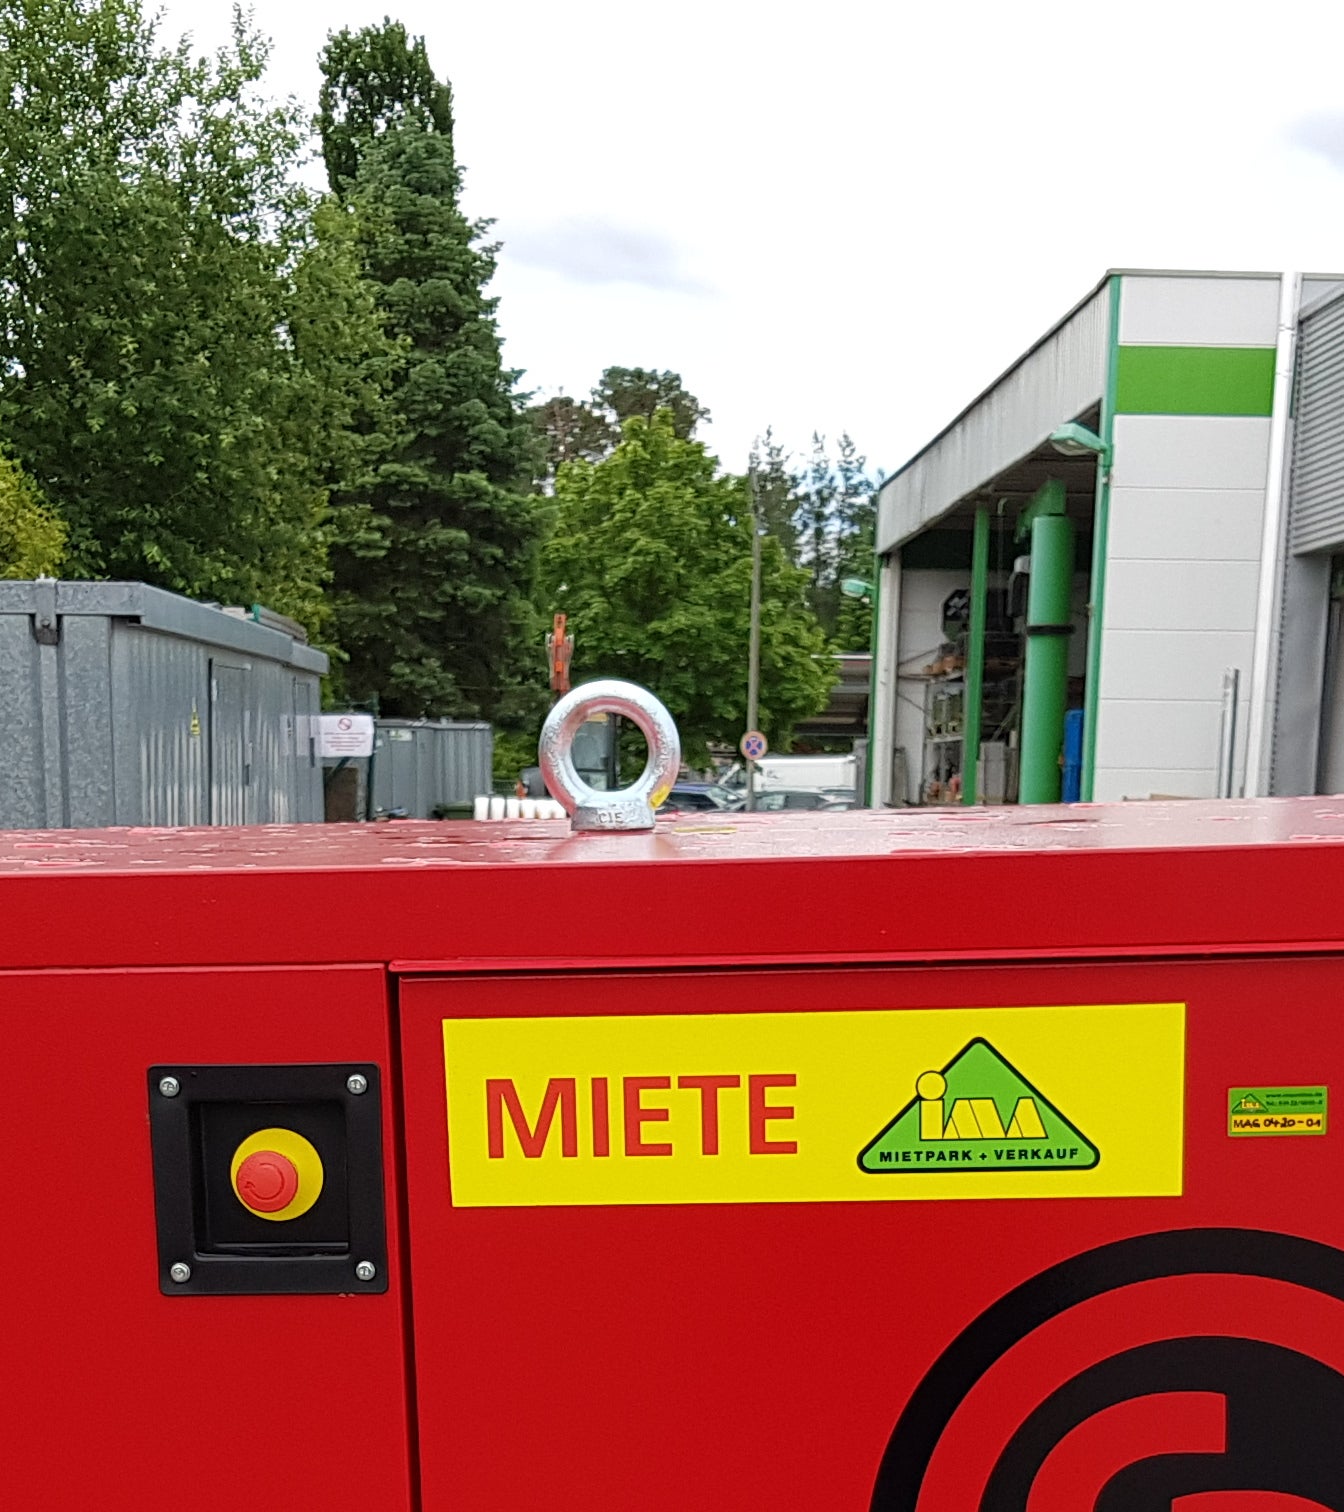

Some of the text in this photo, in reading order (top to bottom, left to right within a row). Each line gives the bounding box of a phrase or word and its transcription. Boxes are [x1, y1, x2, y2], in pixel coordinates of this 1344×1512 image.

[485, 1073, 798, 1159] MIETE
[879, 1150, 973, 1163] MIETPARK
[994, 1148, 1079, 1161] VERKAUF
